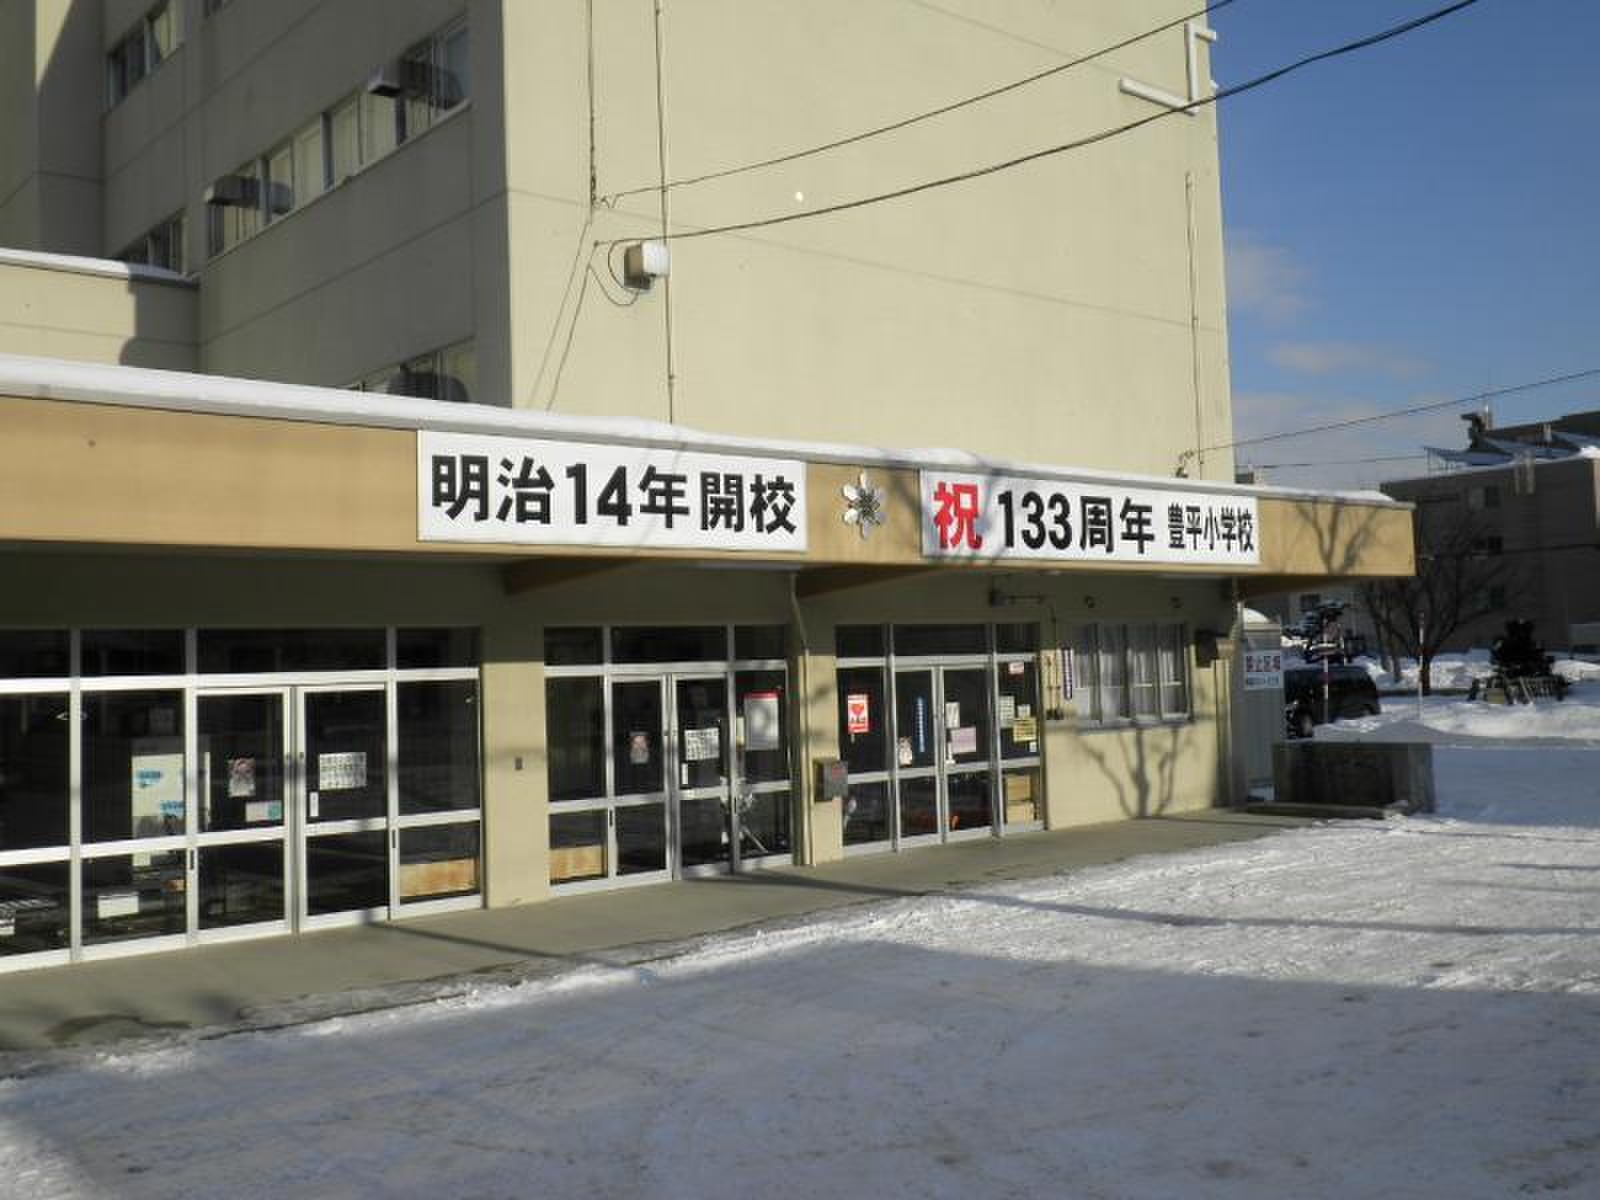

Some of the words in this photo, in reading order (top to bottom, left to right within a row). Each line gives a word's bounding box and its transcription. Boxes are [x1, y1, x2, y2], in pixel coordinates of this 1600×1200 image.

[431, 454, 796, 533] 明治14年開校
[933, 481, 982, 550] 祝
[998, 490, 1155, 554] 133周年
[1167, 503, 1254, 552] 豊平小学校
